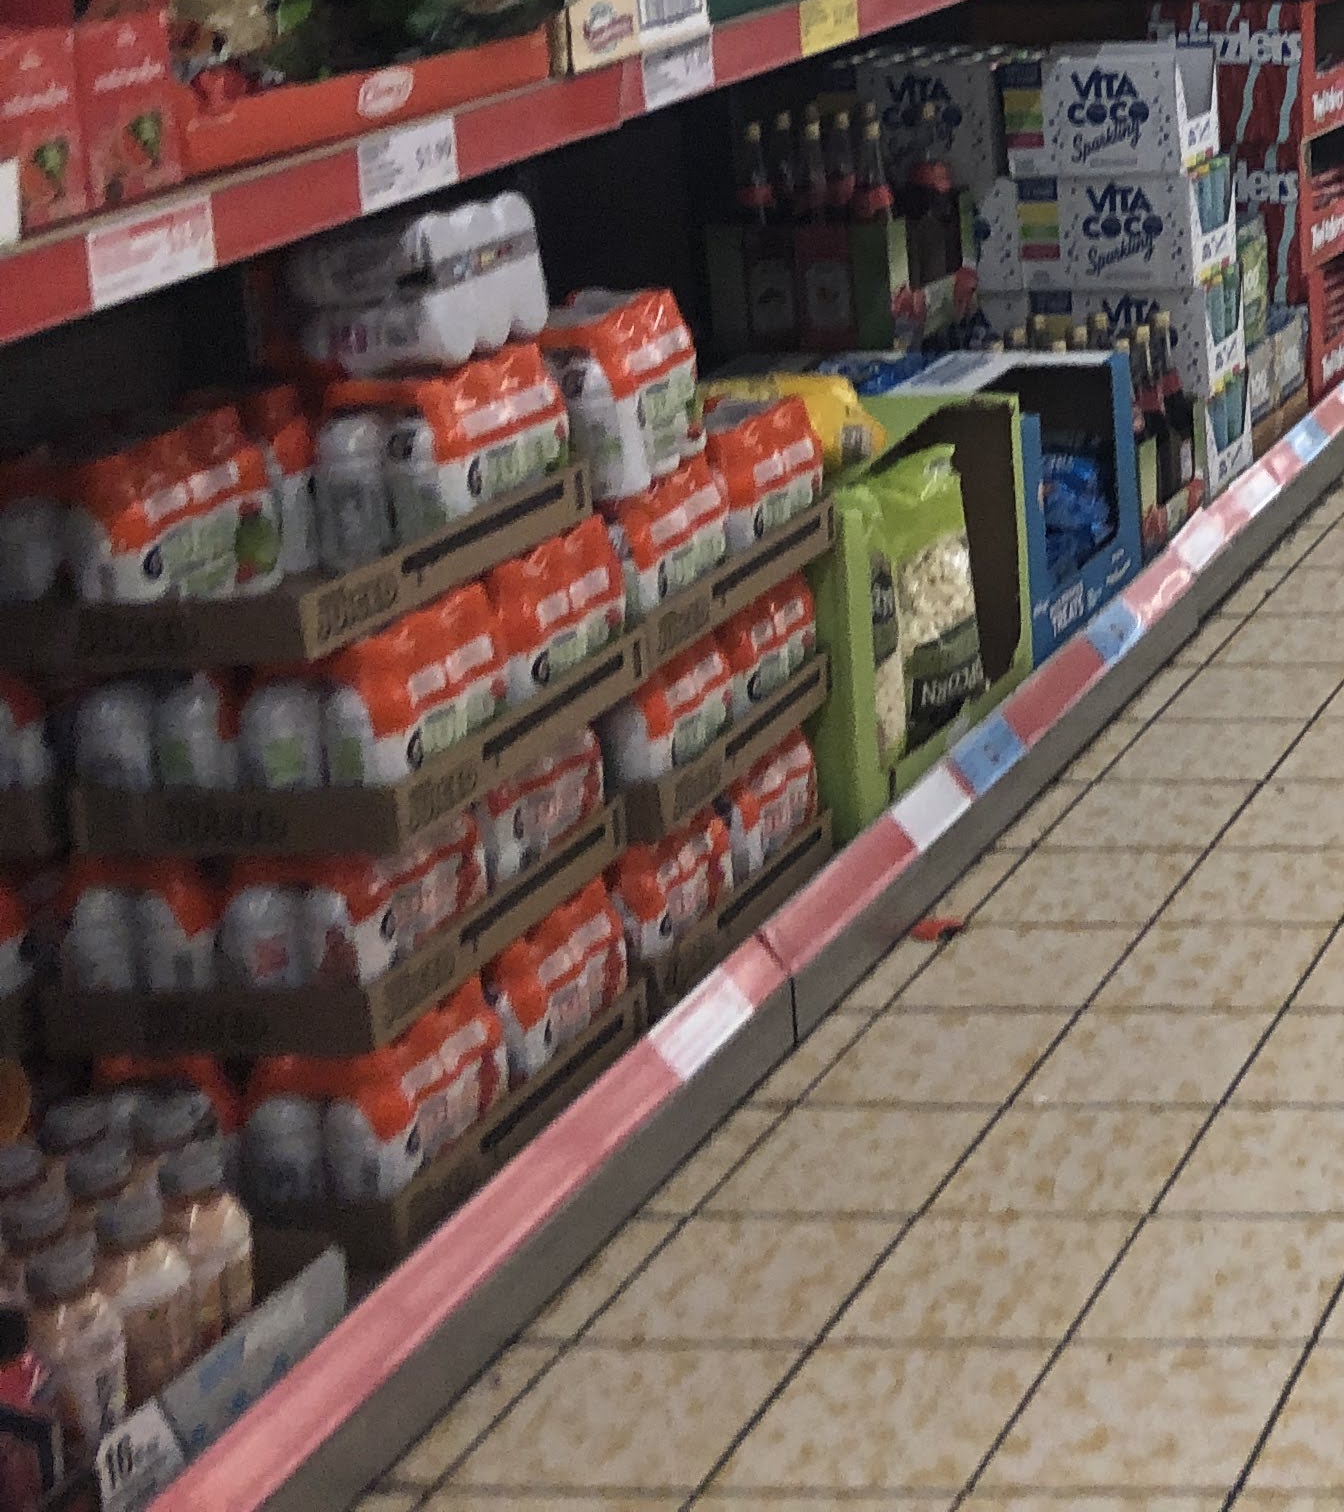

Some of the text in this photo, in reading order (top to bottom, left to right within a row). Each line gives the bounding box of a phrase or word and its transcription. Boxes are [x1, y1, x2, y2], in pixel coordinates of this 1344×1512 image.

[1070, 68, 1139, 99] VITA
[1067, 101, 1150, 128] COCO
[1071, 117, 1142, 164] Sparkling
[1086, 182, 1152, 215] VITA
[1082, 215, 1163, 240] COCO
[1087, 228, 1154, 276] Sparkling
